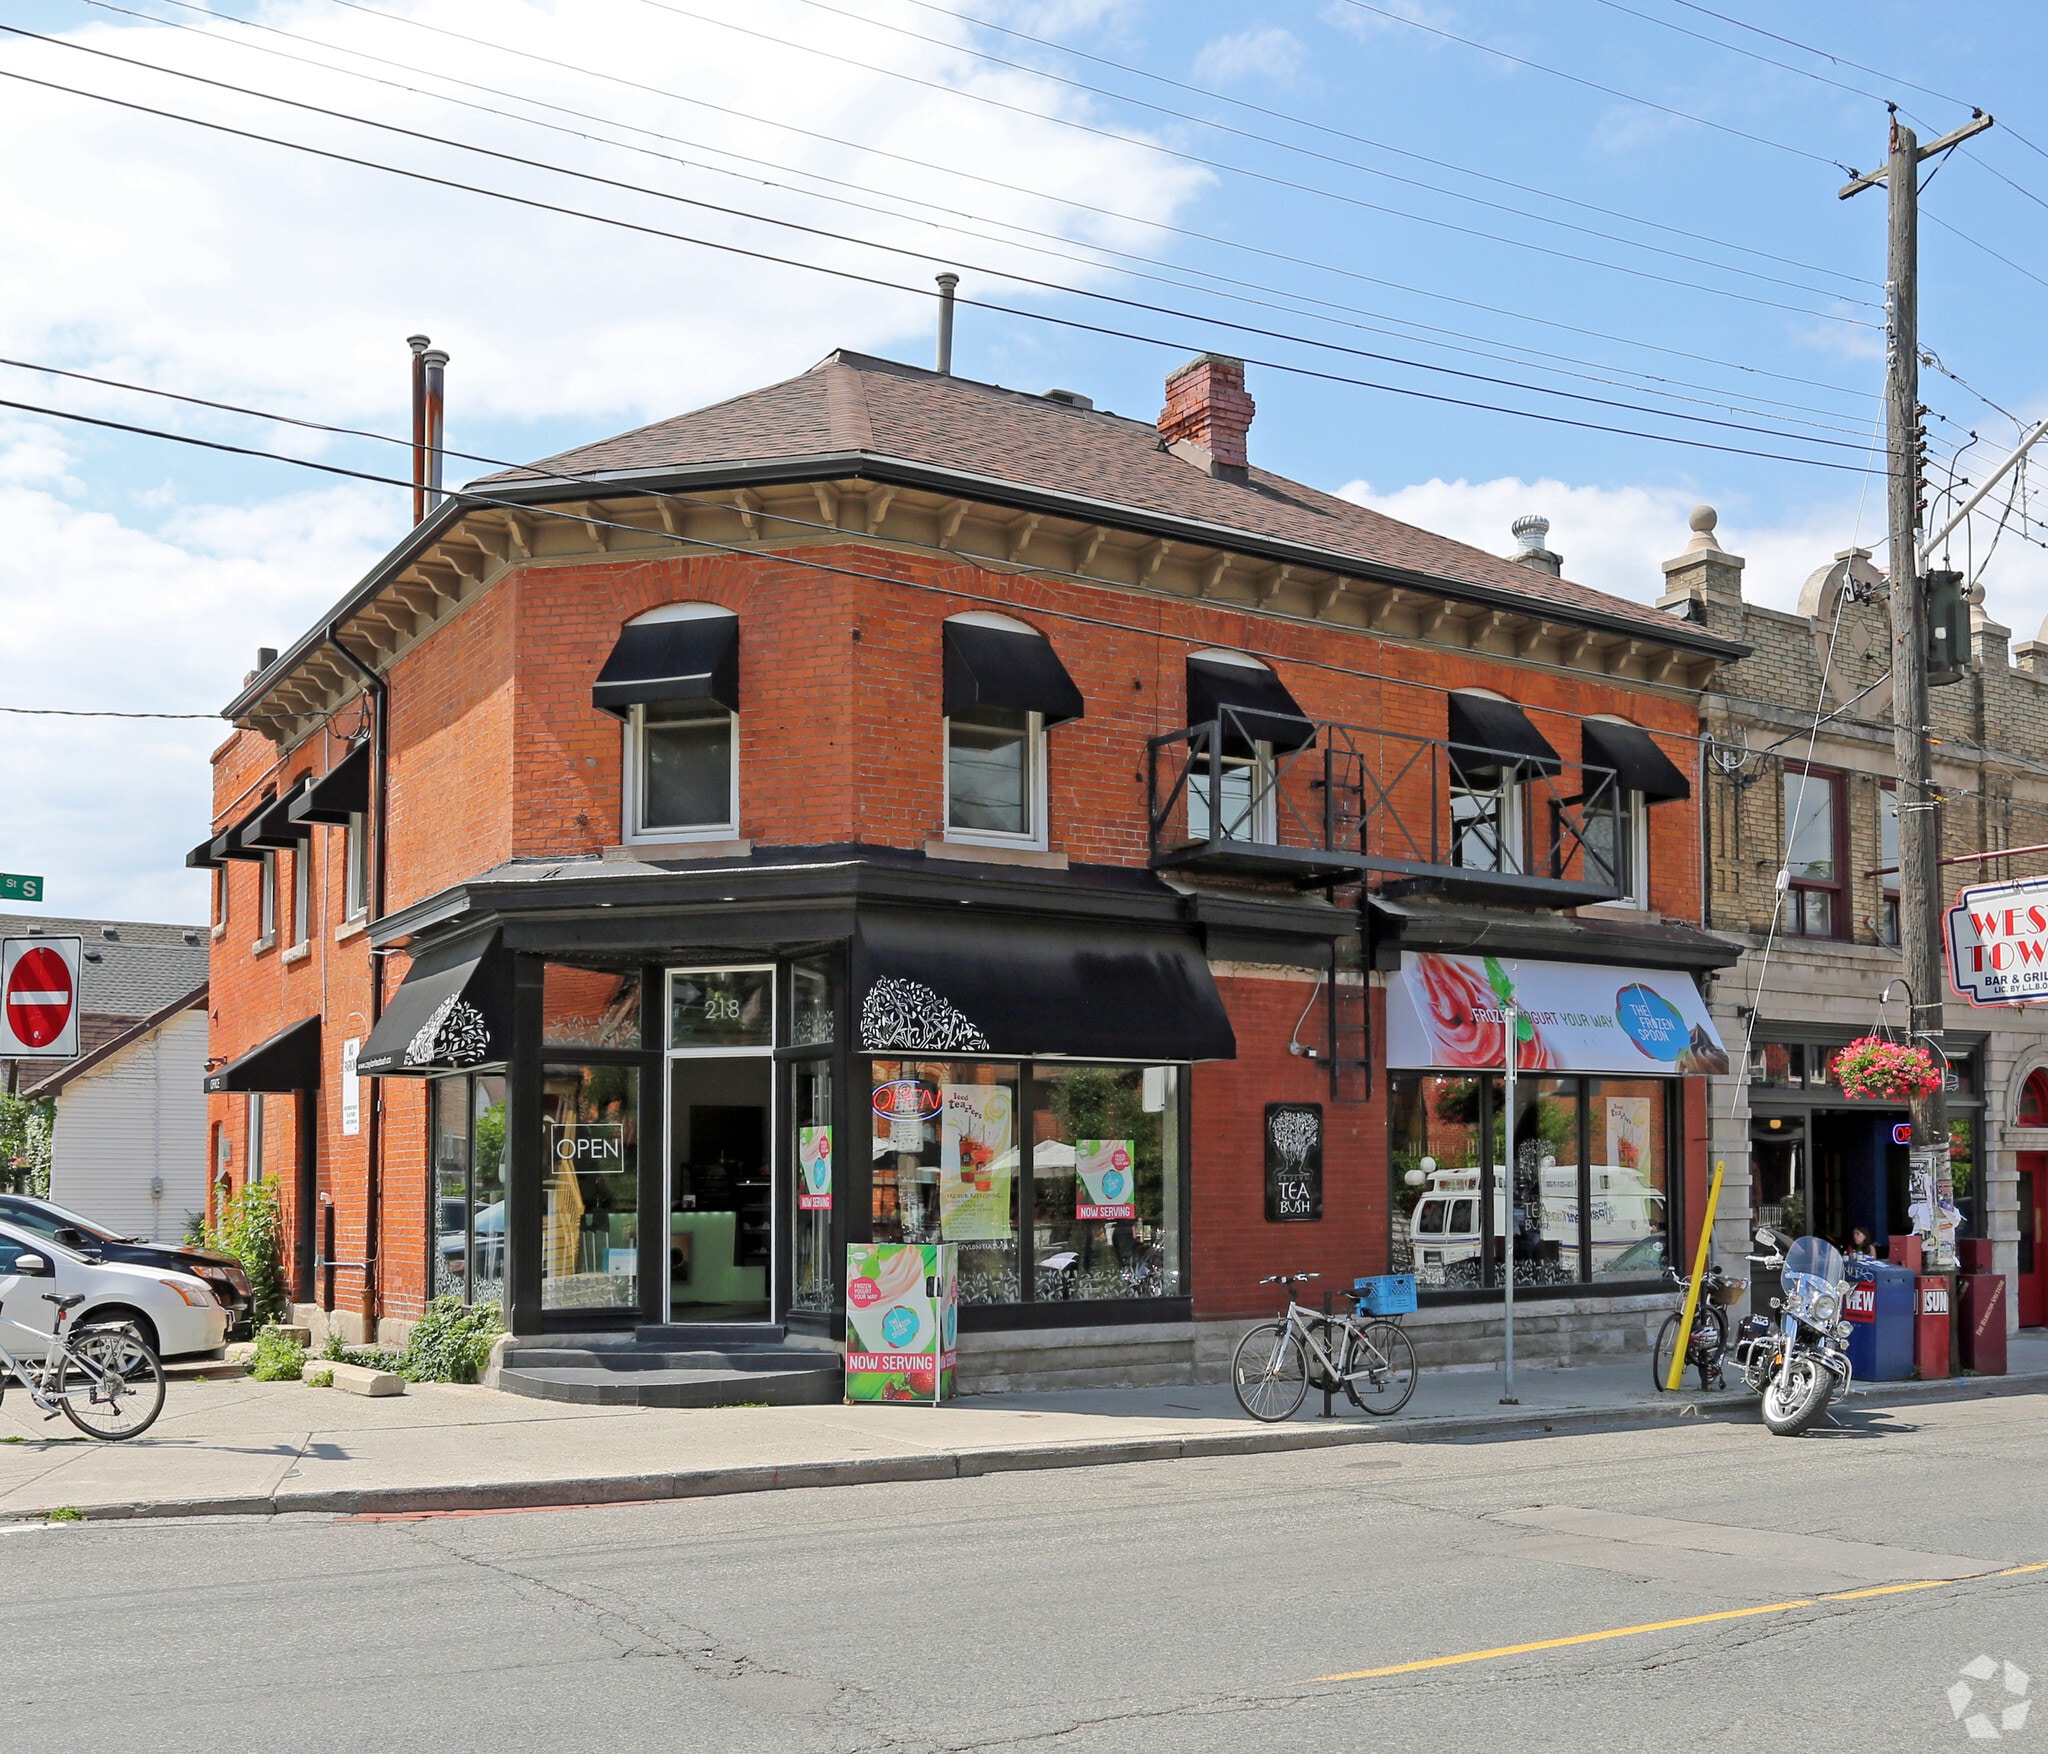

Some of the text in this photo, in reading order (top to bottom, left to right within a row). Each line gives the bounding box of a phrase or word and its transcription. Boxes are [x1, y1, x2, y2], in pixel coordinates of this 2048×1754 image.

[6, 878, 37, 897] St S
[1968, 904, 2048, 940] WES
[1965, 939, 2048, 972] TOW
[1985, 972, 2048, 986] BAR & GRIL
[1994, 982, 2048, 994] LIC. BY L.L.B.O
[705, 999, 740, 1019] 218
[1629, 1004, 1649, 1017] THE
[1472, 1008, 1506, 1024] FROZE
[1560, 1012, 1590, 1027] YOUR
[1590, 1014, 1614, 1029] WAY
[1639, 1016, 1676, 1031] FROZEN
[1637, 1028, 1670, 1042] SPOON
[872, 1088, 943, 1110] OPEN
[953, 1092, 970, 1101] Iced
[1896, 1126, 1911, 1142] OP
[556, 1138, 619, 1159] OPEN
[1278, 1181, 1310, 1200] TEA
[1080, 1205, 1131, 1218] NOW SERVING
[1280, 1199, 1310, 1214] BUSH
[1926, 1291, 1947, 1312] SUN
[849, 1355, 879, 1370] NOW
[882, 1354, 933, 1371] SERVING
